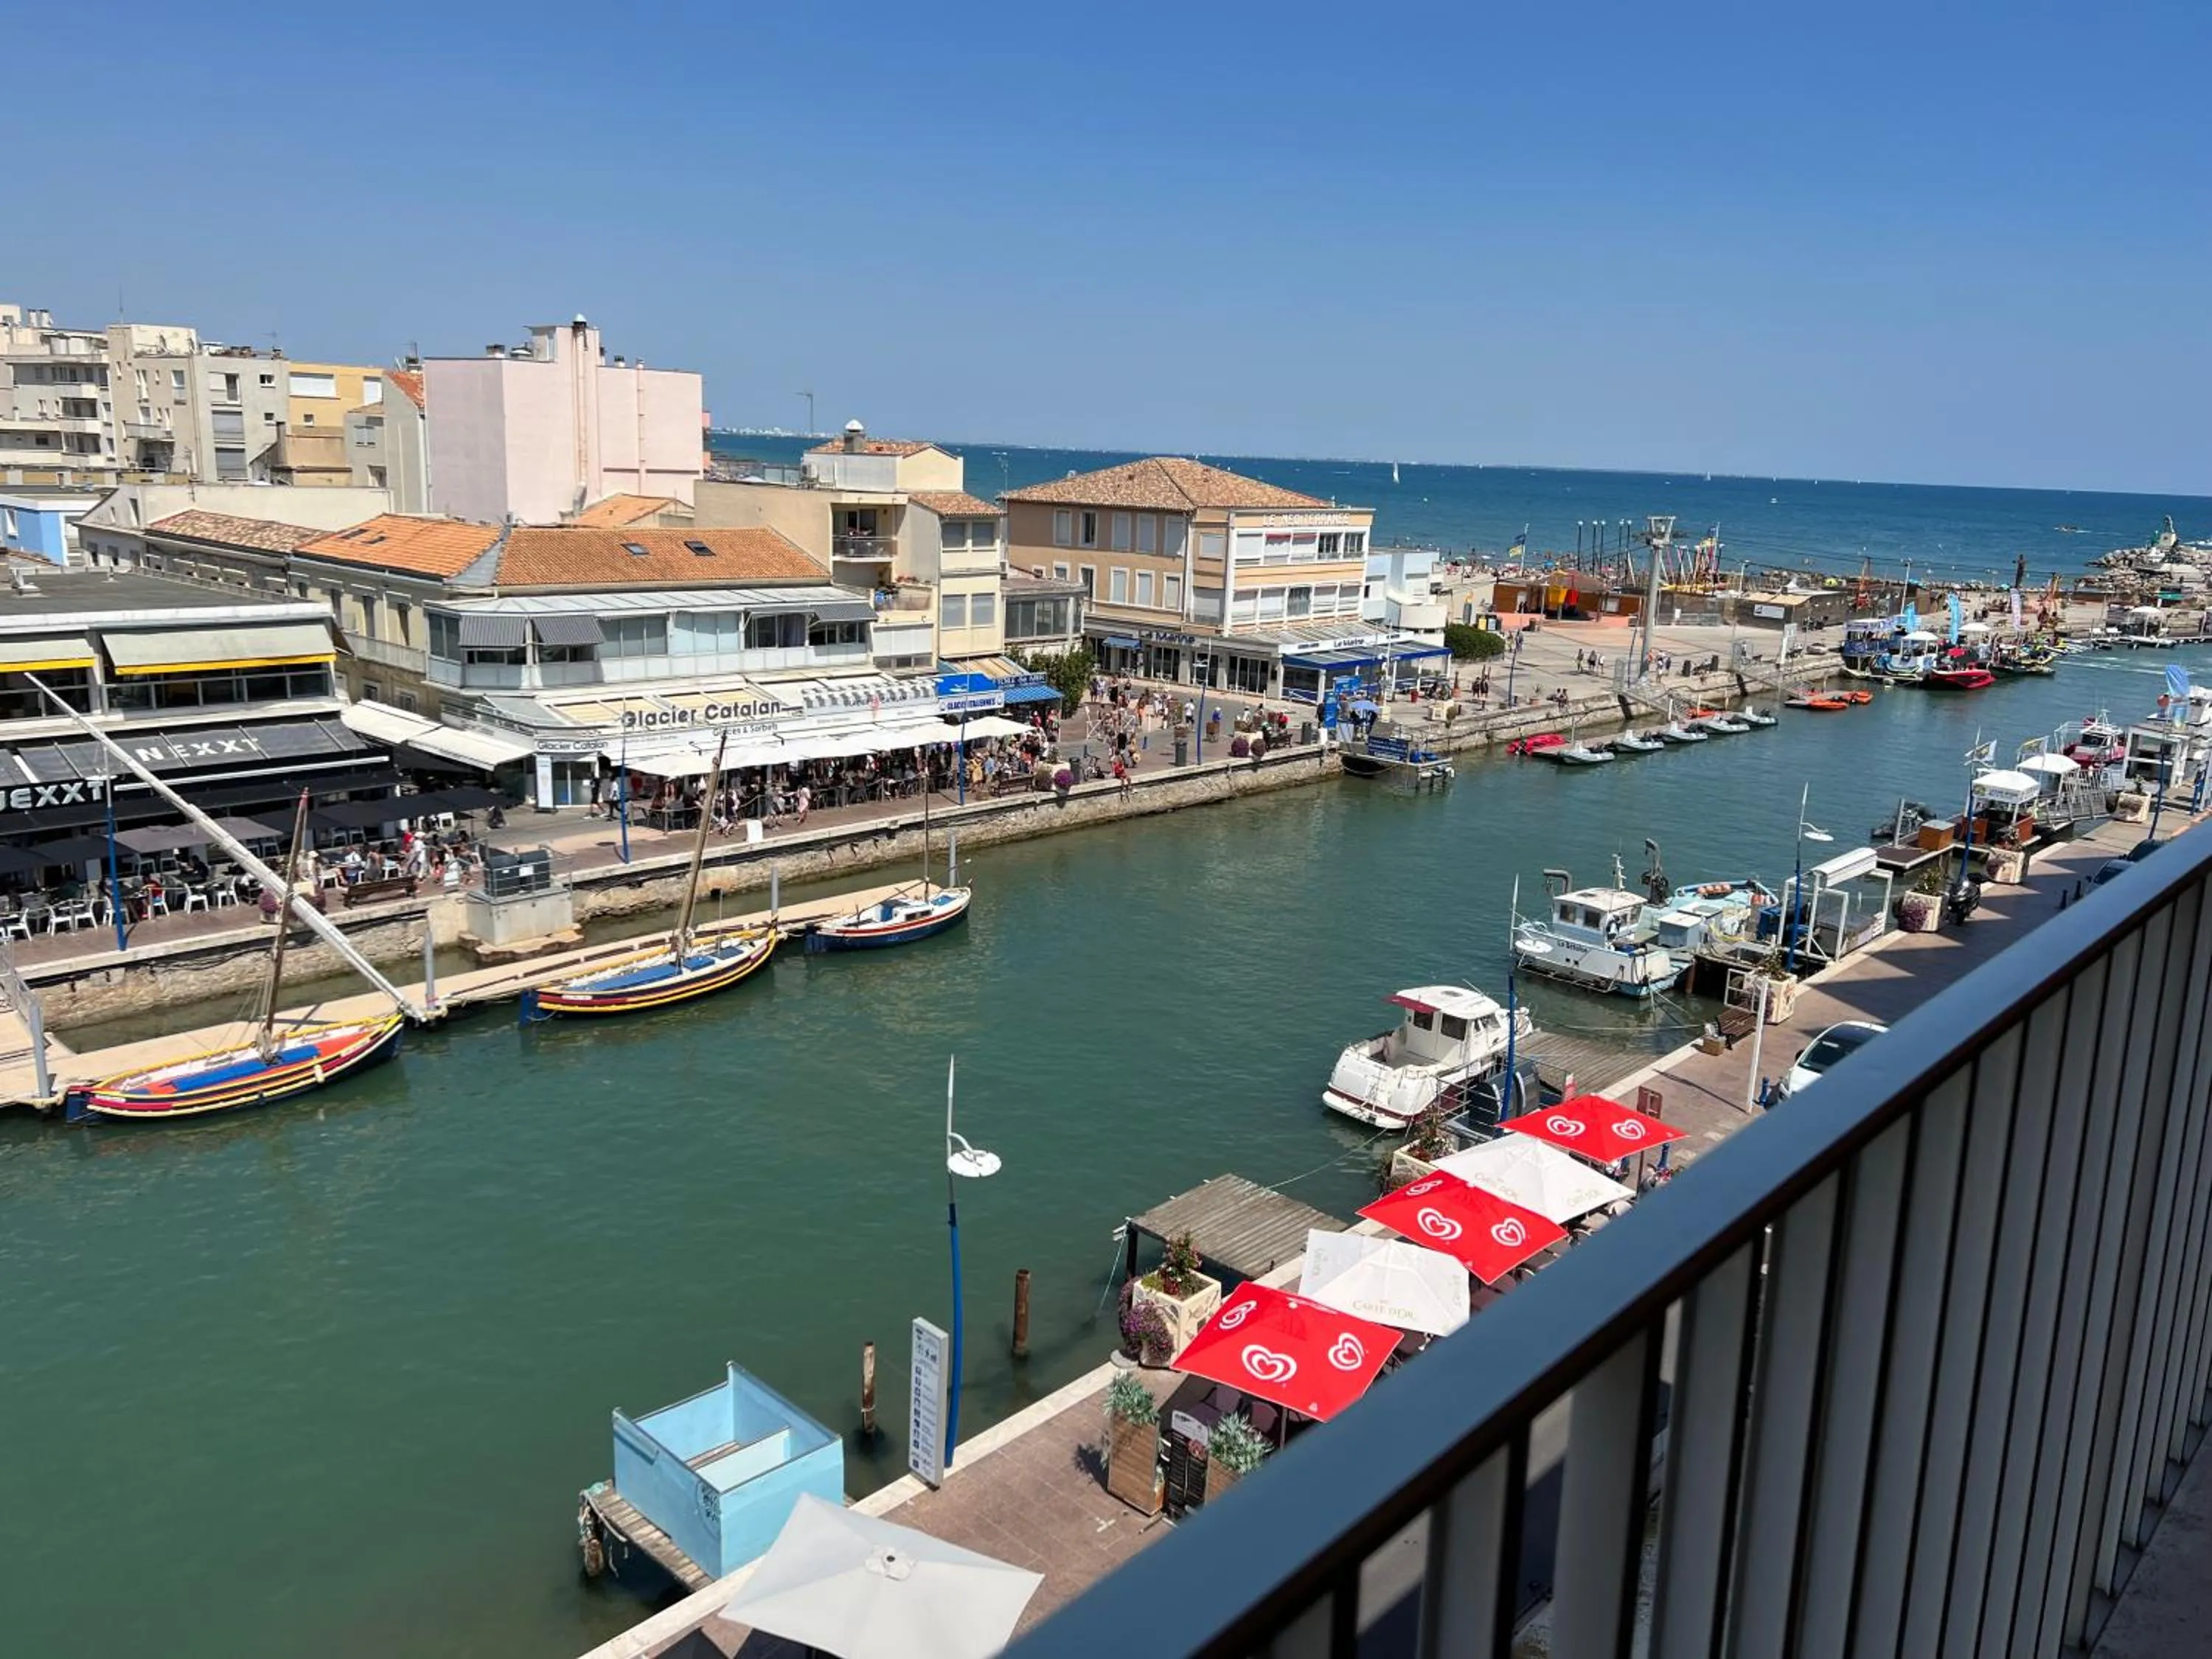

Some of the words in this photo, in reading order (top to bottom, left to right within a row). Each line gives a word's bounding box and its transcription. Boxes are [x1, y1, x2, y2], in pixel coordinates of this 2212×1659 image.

[621, 705, 697, 727] Glacier
[705, 700, 781, 720] Catalan
[134, 737, 260, 762] NEXXT
[537, 740, 571, 750] Glacier
[573, 740, 608, 750] Catalan
[0, 780, 105, 812] EXXT
